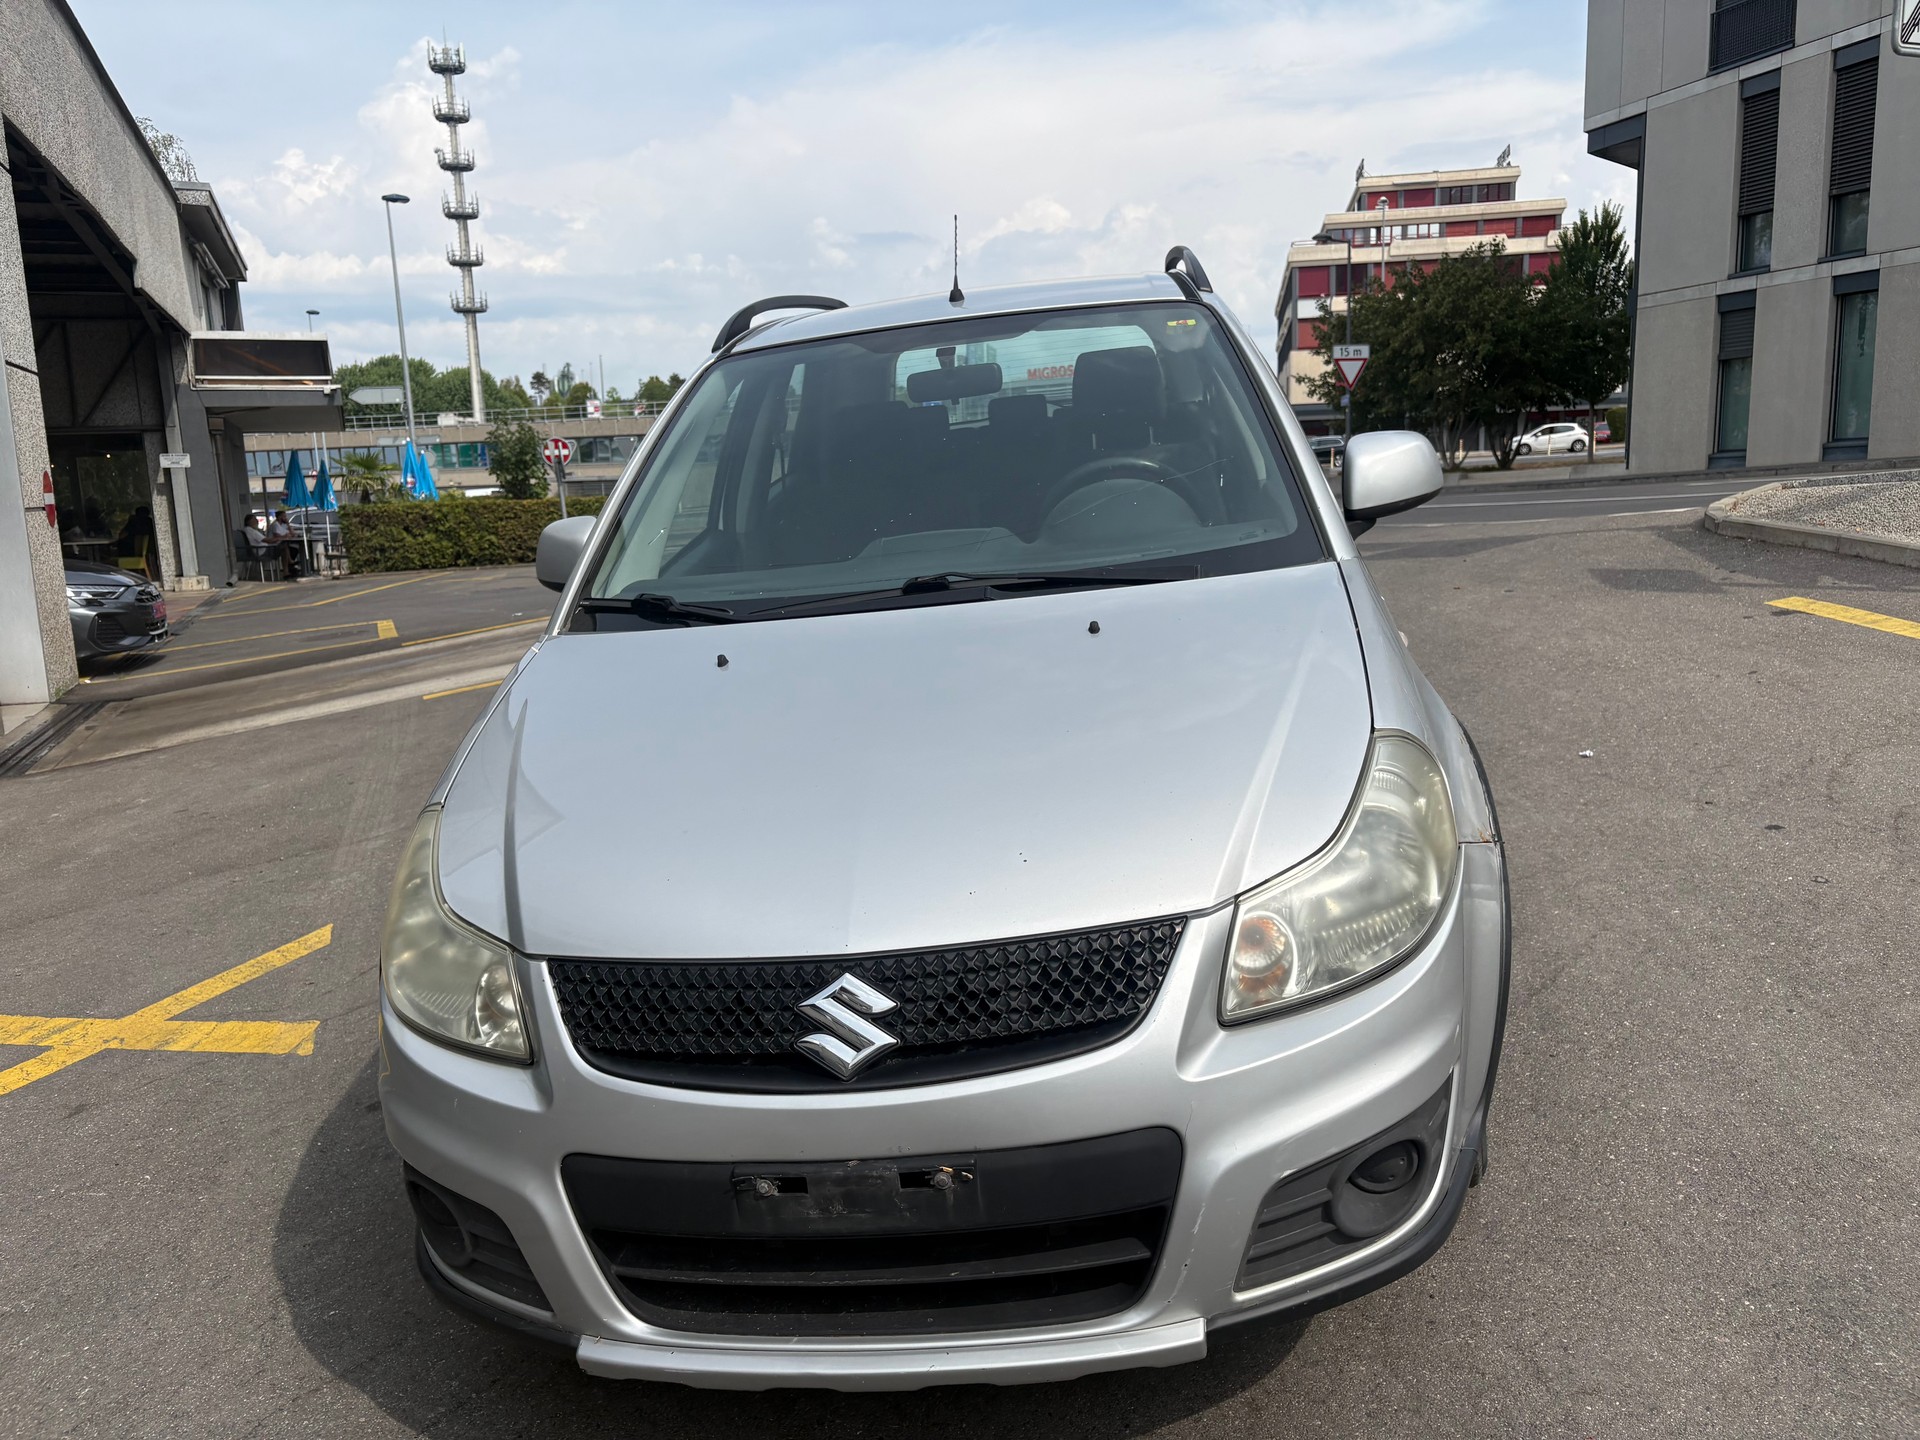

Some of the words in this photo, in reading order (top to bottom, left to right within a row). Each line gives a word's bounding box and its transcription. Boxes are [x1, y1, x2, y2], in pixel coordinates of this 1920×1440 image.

[1340, 347, 1350, 357] 15
[1353, 349, 1362, 357] m
[1027, 365, 1073, 380] MIGROS
